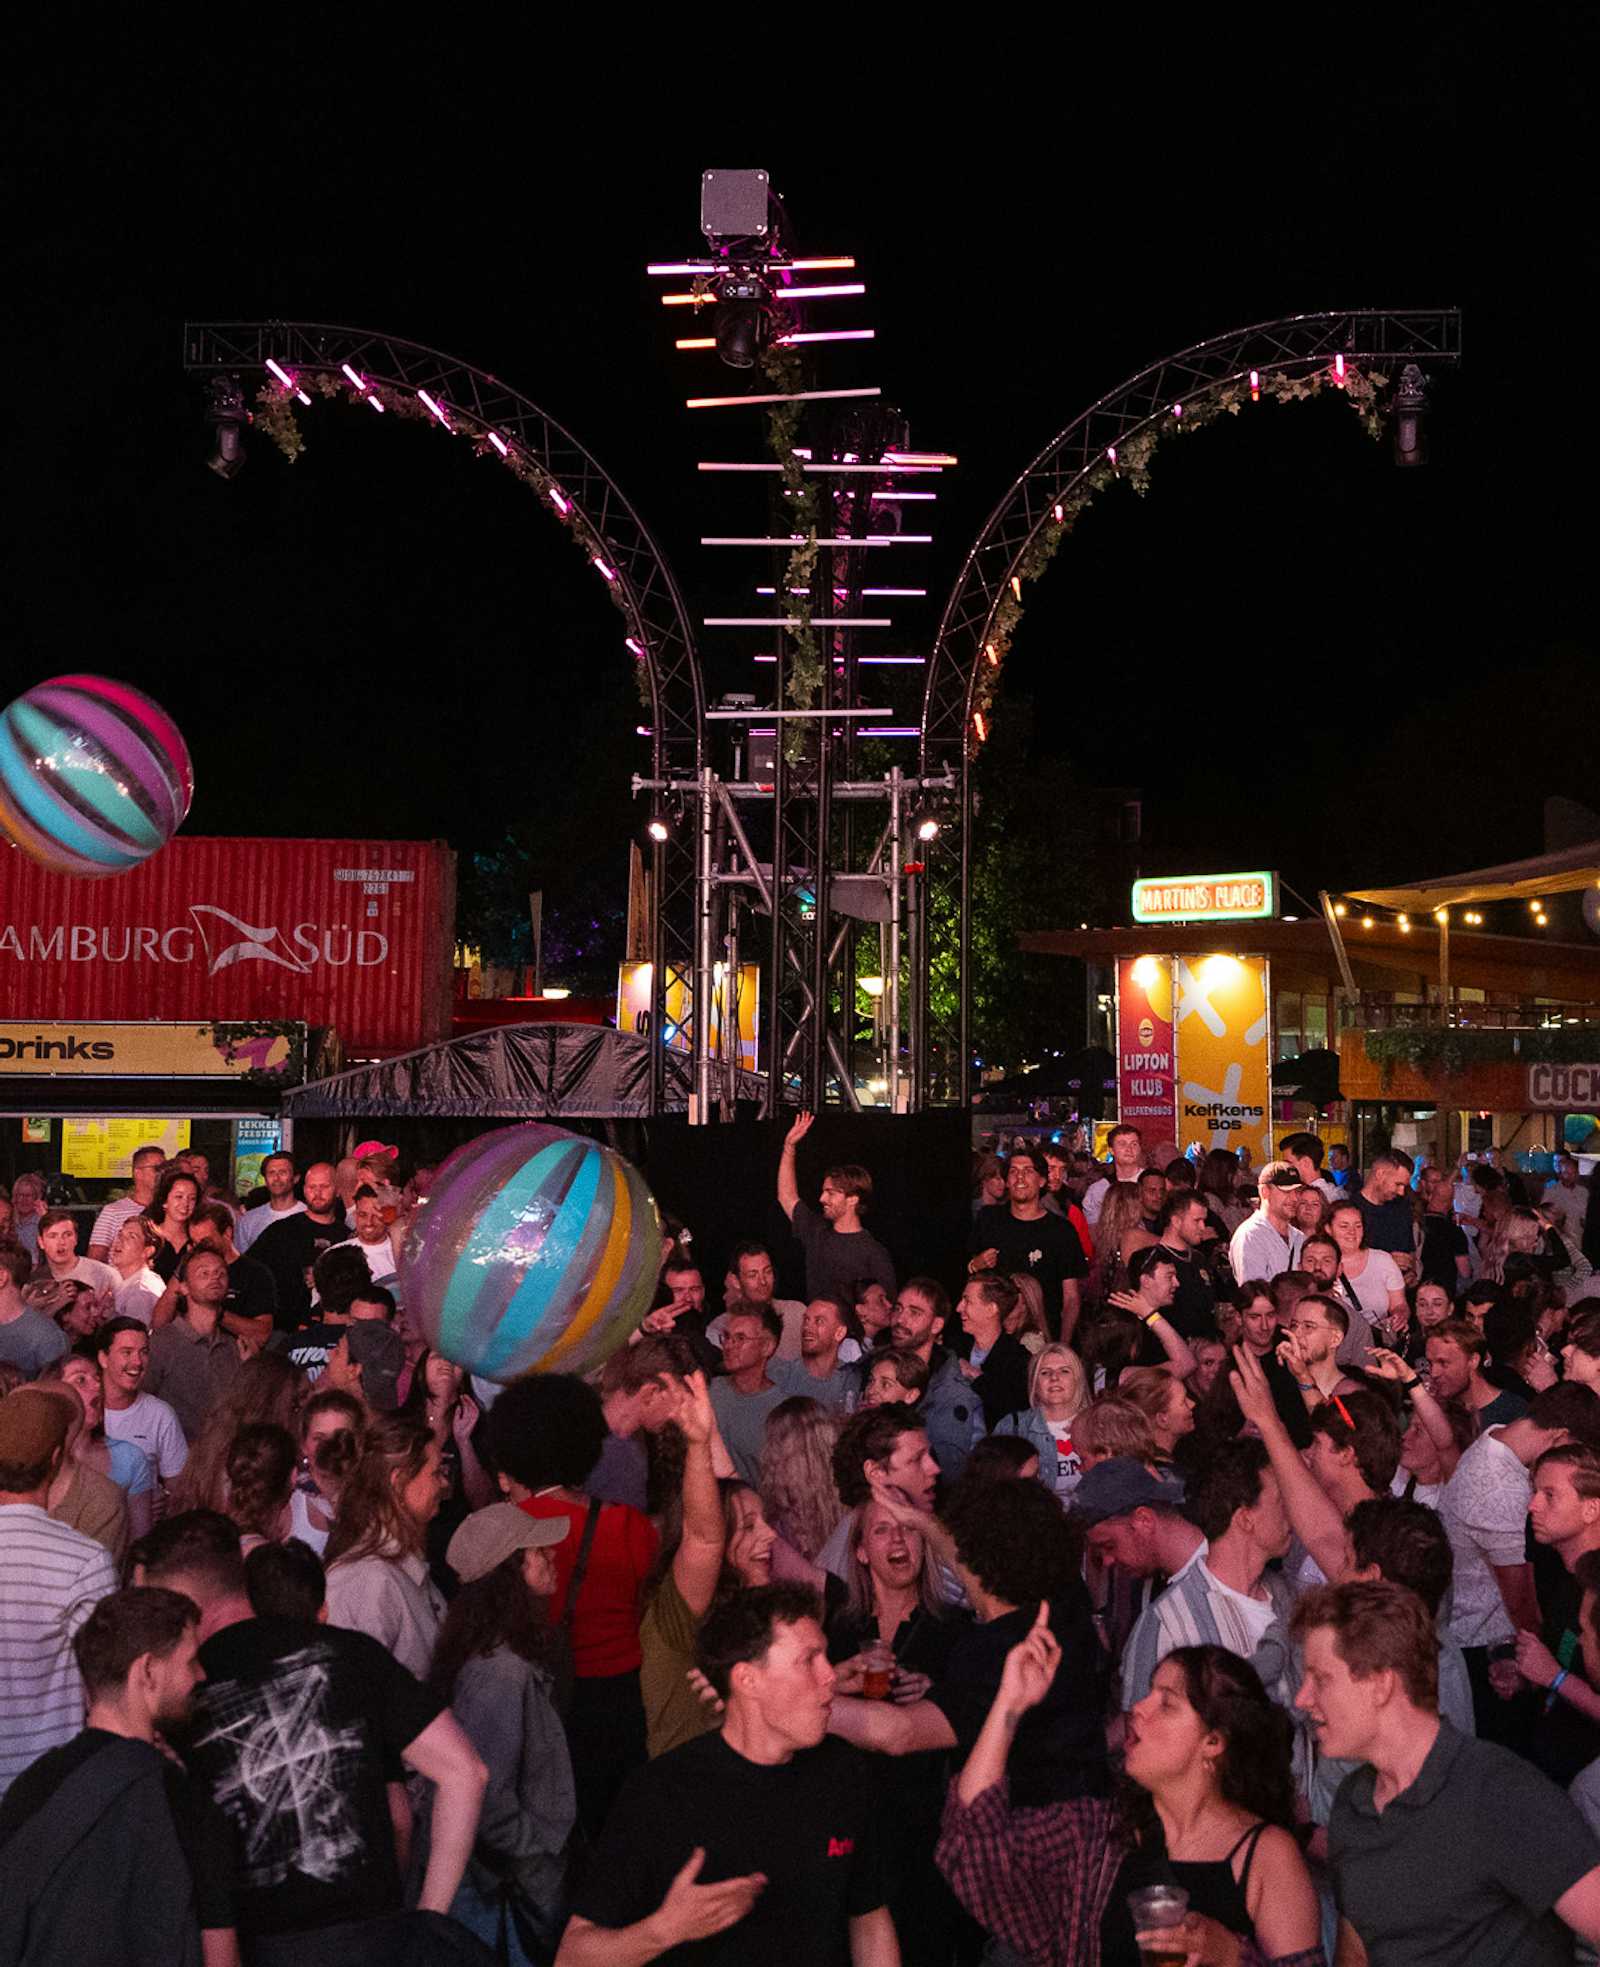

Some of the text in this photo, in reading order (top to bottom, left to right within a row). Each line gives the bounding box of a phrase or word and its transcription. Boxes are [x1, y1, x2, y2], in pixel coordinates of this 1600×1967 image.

[1141, 883, 1262, 912] MARTIN'S PLACE
[293, 922, 389, 966] SÜD
[0, 1035, 115, 1060] Drinks
[1124, 1052, 1169, 1071] LIPTON
[1131, 1079, 1164, 1097] KLUB
[1184, 1103, 1264, 1117] Kelfkens
[239, 1120, 279, 1129] LEKKER
[1208, 1119, 1242, 1130] Bos
